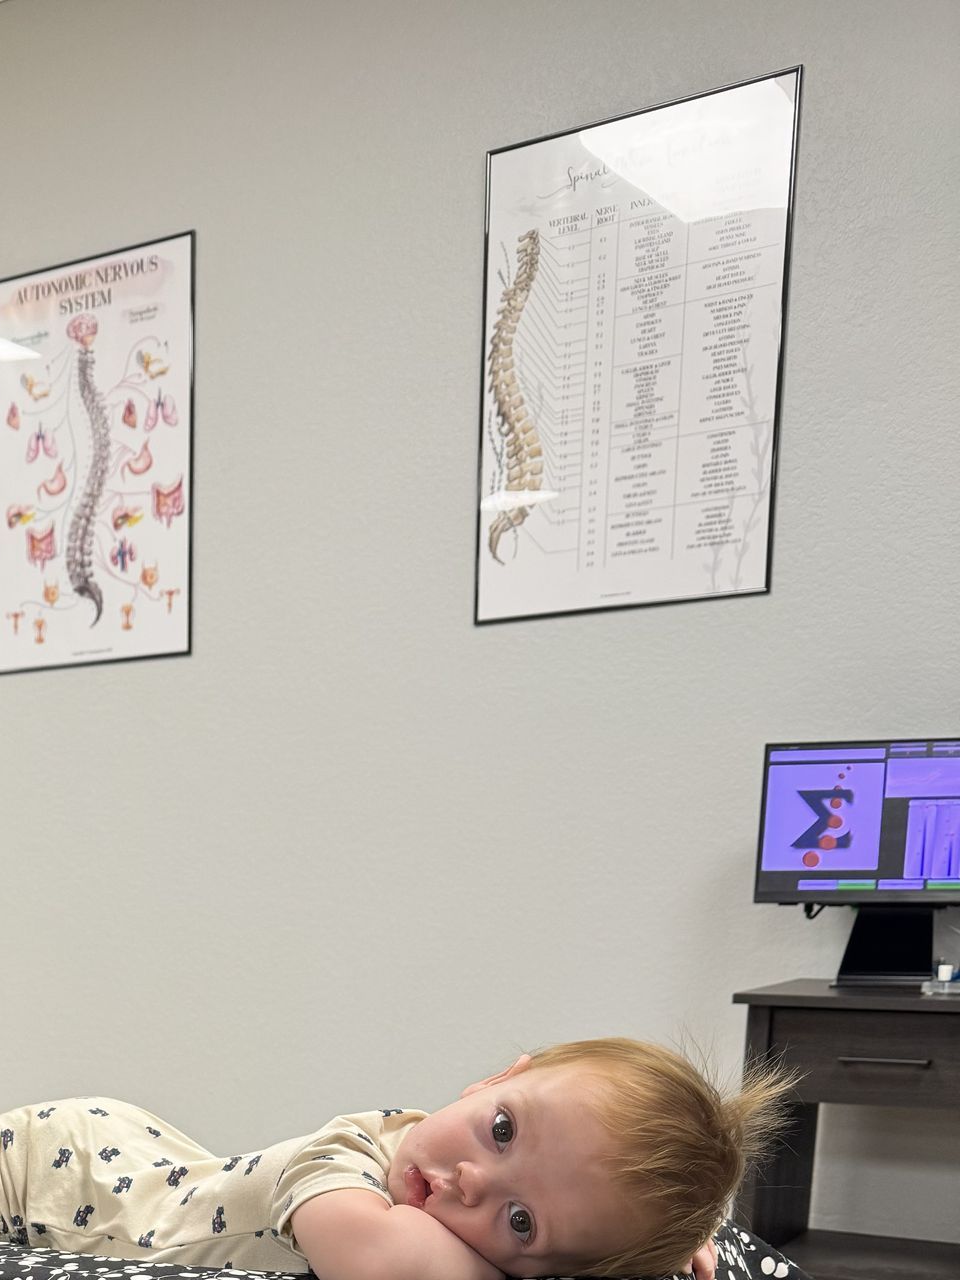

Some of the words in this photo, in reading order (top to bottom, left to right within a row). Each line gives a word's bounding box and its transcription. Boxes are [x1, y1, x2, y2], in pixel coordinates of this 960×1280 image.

[596, 214, 617, 226] ROOT
[16, 273, 91, 305] AUTONOMIC
[95, 255, 159, 284] NERVOUS
[59, 288, 112, 315] SYSTEM
